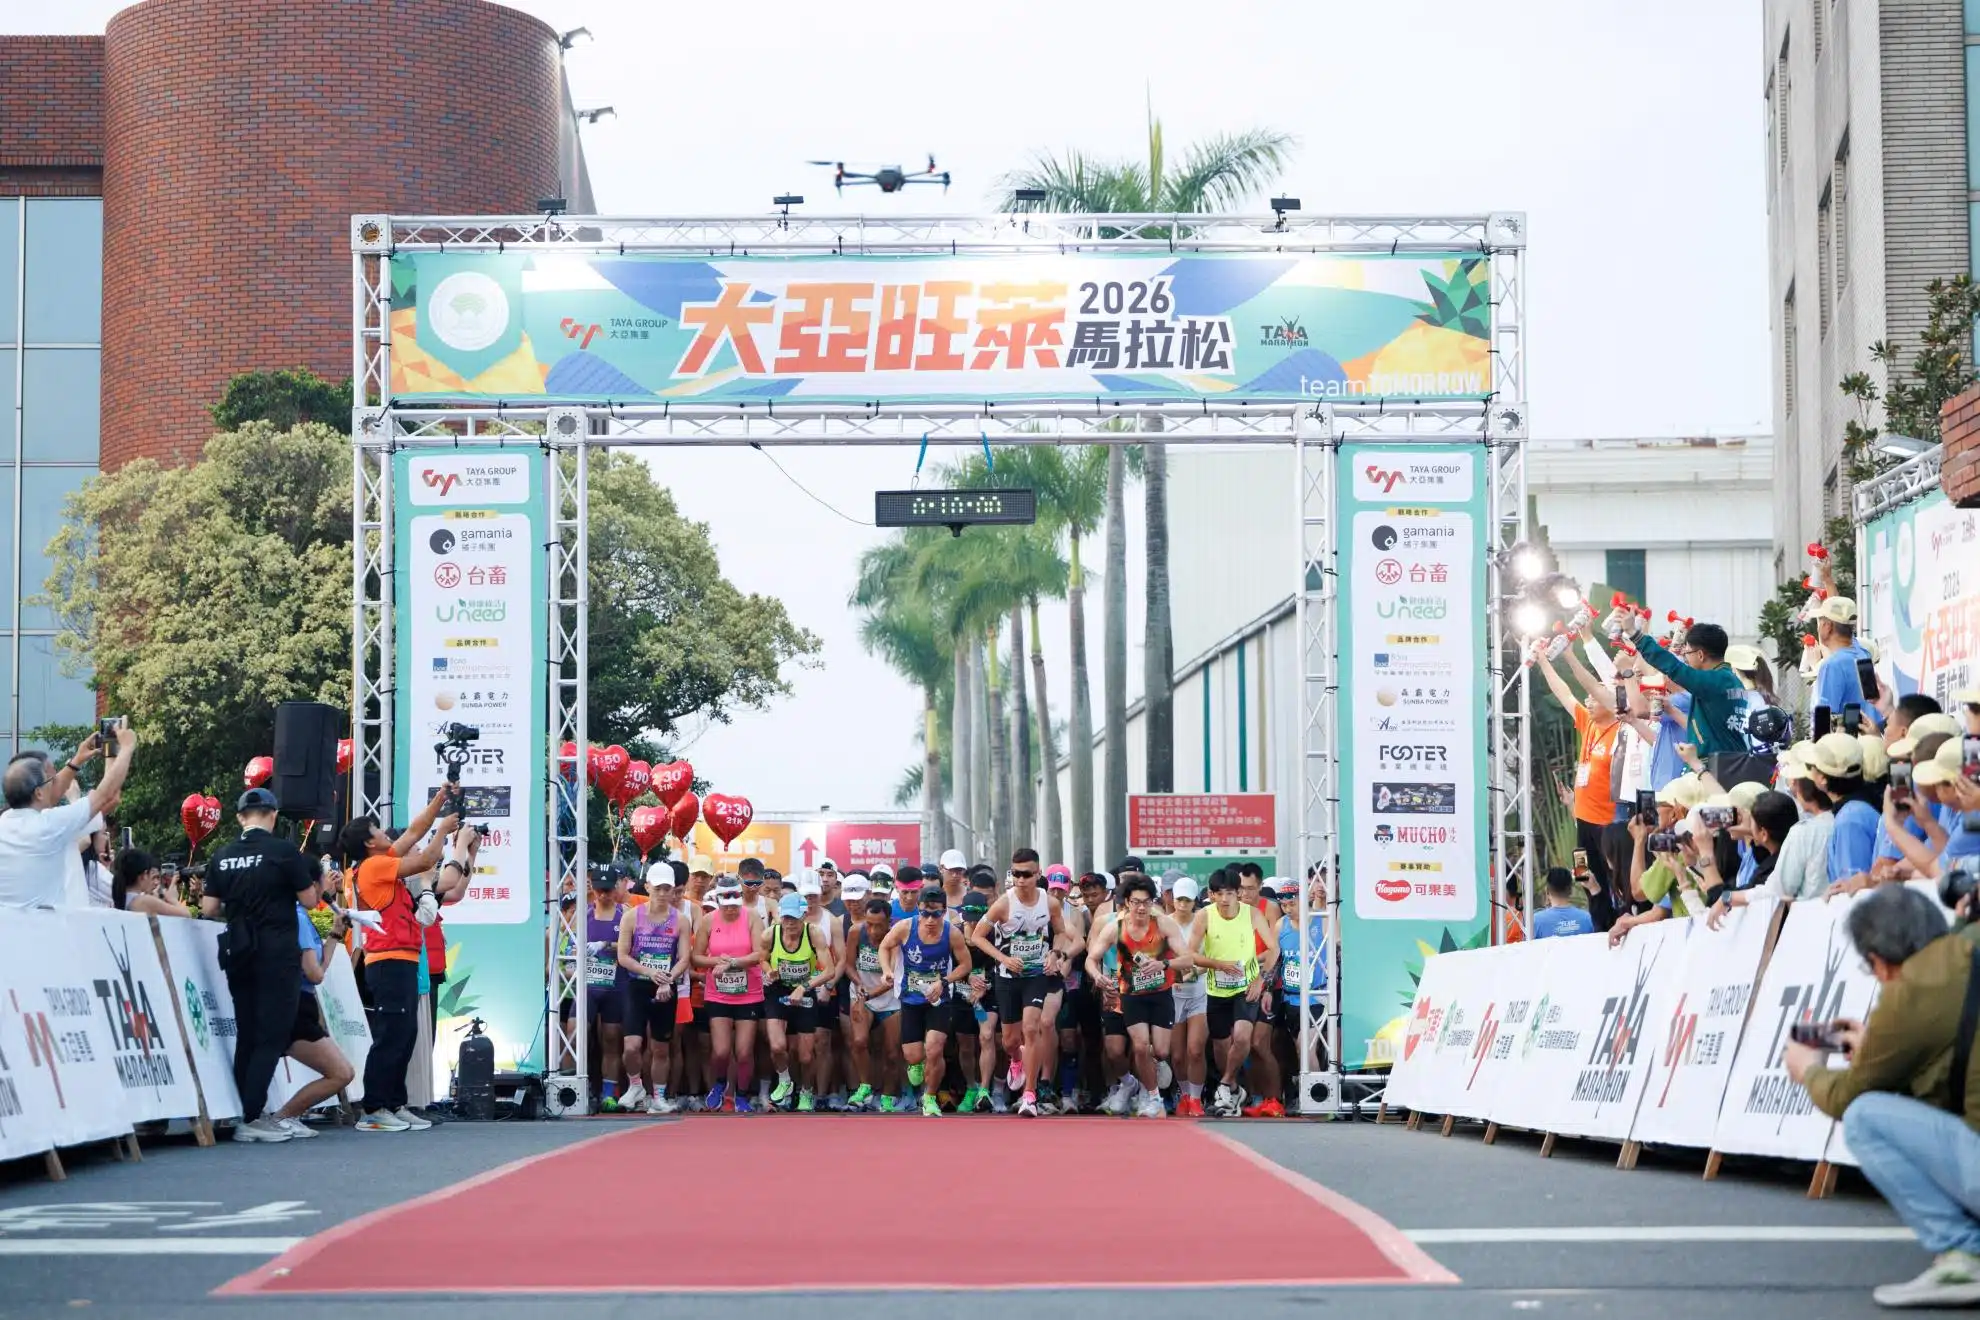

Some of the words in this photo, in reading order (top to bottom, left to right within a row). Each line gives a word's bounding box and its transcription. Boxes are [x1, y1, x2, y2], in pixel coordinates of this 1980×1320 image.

[1080, 281, 1170, 314] 2026
[610, 319, 632, 328] TAYA
[635, 319, 668, 328] GROUP
[676, 281, 1067, 373] 大亞旺萊
[1067, 321, 1230, 369] 馬拉松
[1301, 375, 1365, 396] team
[1368, 372, 1482, 395] TOMORROW
[466, 467, 486, 476] TAYA
[488, 467, 517, 476] GROUP
[1410, 466, 1430, 474] TAYA
[1432, 466, 1461, 474] GROUP
[461, 528, 513, 541] gamania
[1403, 525, 1455, 538] gamania
[467, 565, 507, 585] 台畜
[1409, 562, 1449, 583] 台畜
[592, 753, 621, 766] 1:50
[1380, 745, 1447, 761] FOOTER
[602, 764, 616, 772] 21K
[625, 780, 641, 791] 21K
[658, 783, 673, 792] 21K
[196, 805, 221, 820] 1:38
[716, 801, 751, 818] 2:30
[726, 816, 743, 825] 21K
[219, 855, 263, 871] STAFF
[468, 888, 511, 900] 可果美
[1414, 884, 1457, 897] 可果美
[1013, 944, 1040, 952] 50246
[862, 954, 878, 964] 502
[587, 966, 613, 976] 50902
[1286, 968, 1300, 979] 501
[113, 1053, 175, 1089] MARATHON
[1571, 1069, 1631, 1102] MARATHON
